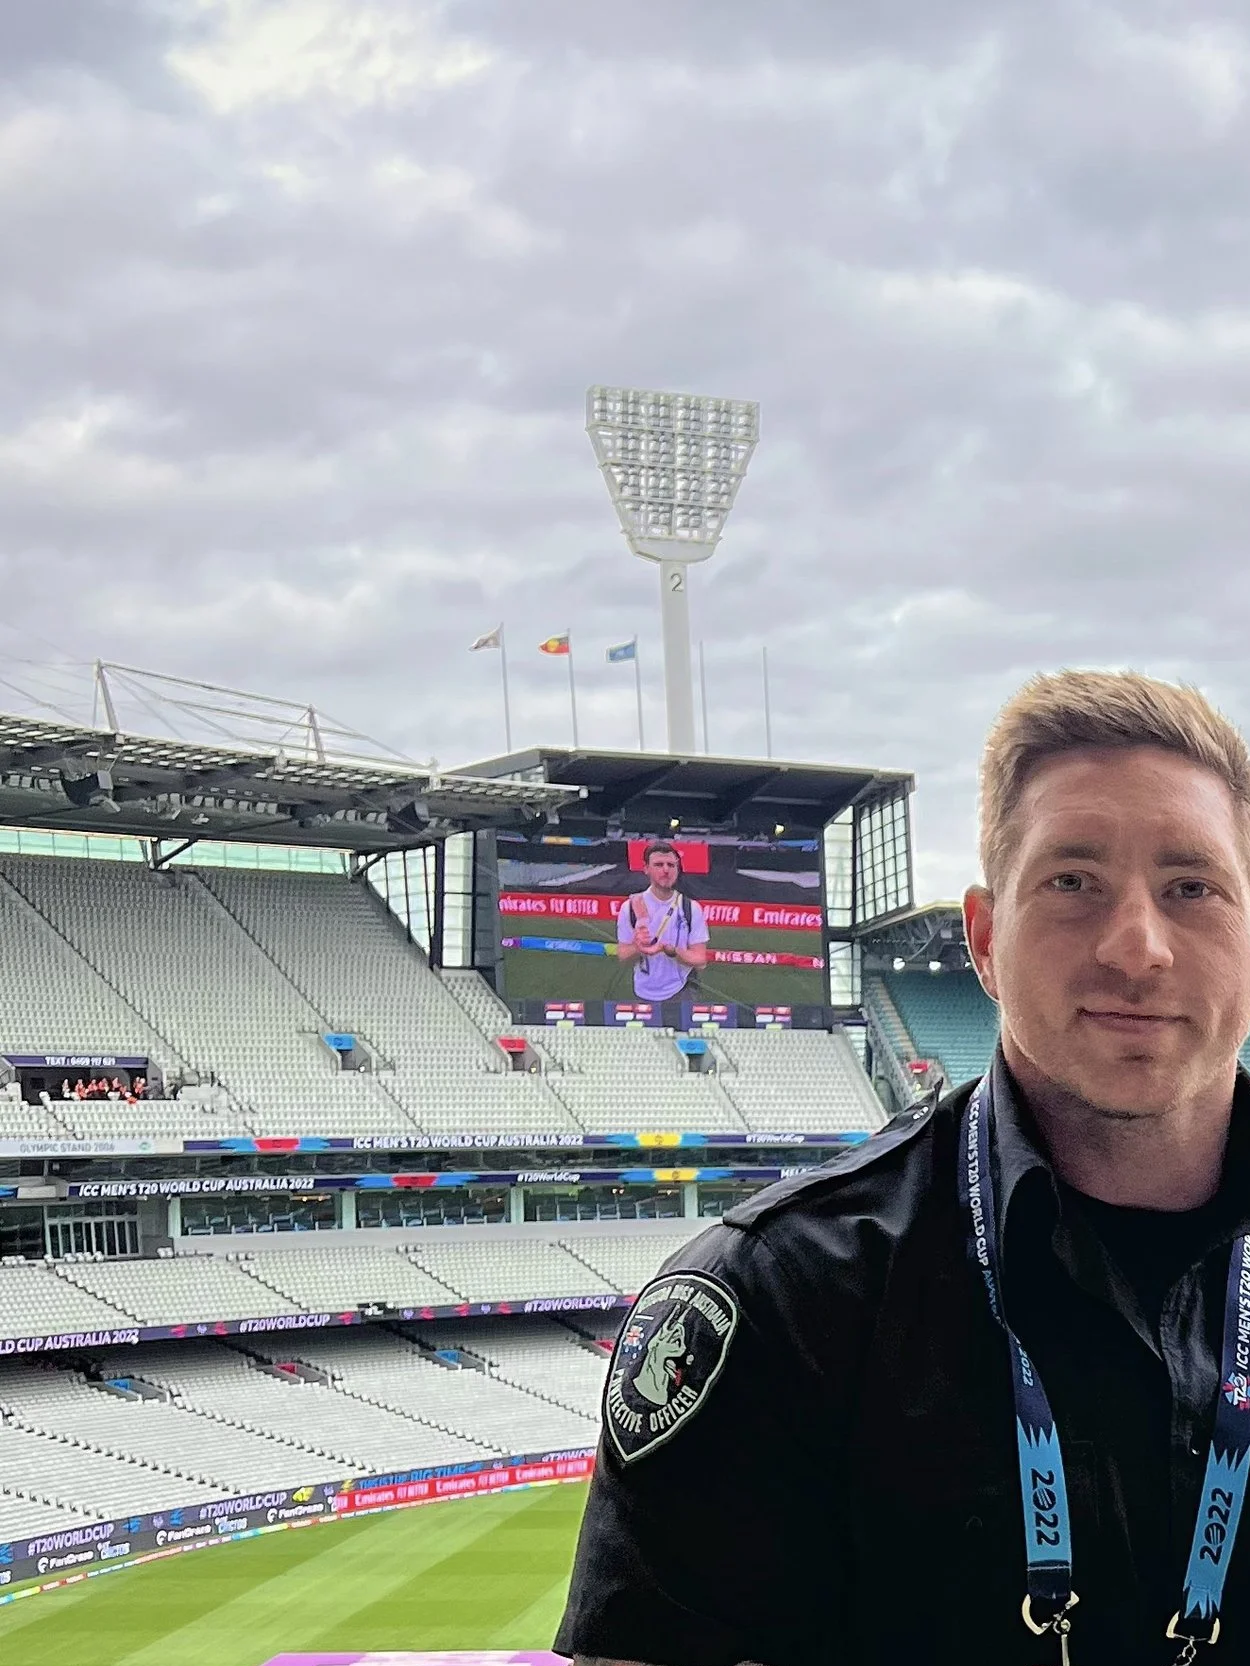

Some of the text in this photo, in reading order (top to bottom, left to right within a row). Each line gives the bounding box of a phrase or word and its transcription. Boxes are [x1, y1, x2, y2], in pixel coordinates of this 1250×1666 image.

[670, 572, 684, 593] 2
[753, 907, 823, 928] Emirates
[715, 951, 778, 964] NISSAN
[60, 1143, 92, 1153] STAND
[354, 1138, 371, 1148] ICC
[410, 1137, 429, 1148] T20
[431, 1136, 471, 1147] WORLD
[474, 1136, 496, 1147] CUP
[499, 1135, 556, 1146] AUSTRALIA
[558, 1134, 583, 1145] 2022
[79, 1185, 98, 1196] ICC
[138, 1183, 158, 1195] T20
[159, 1182, 200, 1194] WORLD
[202, 1181, 225, 1193] CUP
[226, 1179, 288, 1192] AUSTRALIA
[290, 1178, 314, 1190] 2022
[968, 1184, 985, 1236] WORLD
[976, 1237, 989, 1266] CUP
[524, 1296, 616, 1313] #T20WORLDCUP
[688, 1290, 732, 1337] AUSTRALIA
[239, 1313, 330, 1333] #T20WORLDCUP
[17, 1338, 45, 1350] CUP
[46, 1332, 112, 1349] AUSTRALIA
[1236, 1343, 1250, 1370] ICC
[650, 1385, 699, 1433] OFFICER
[200, 1492, 287, 1519] #T20WORLDCUP
[1030, 1467, 1061, 1547] 2022
[1200, 1487, 1232, 1565] 2022
[28, 1523, 115, 1556] #T20WORLDCUP
